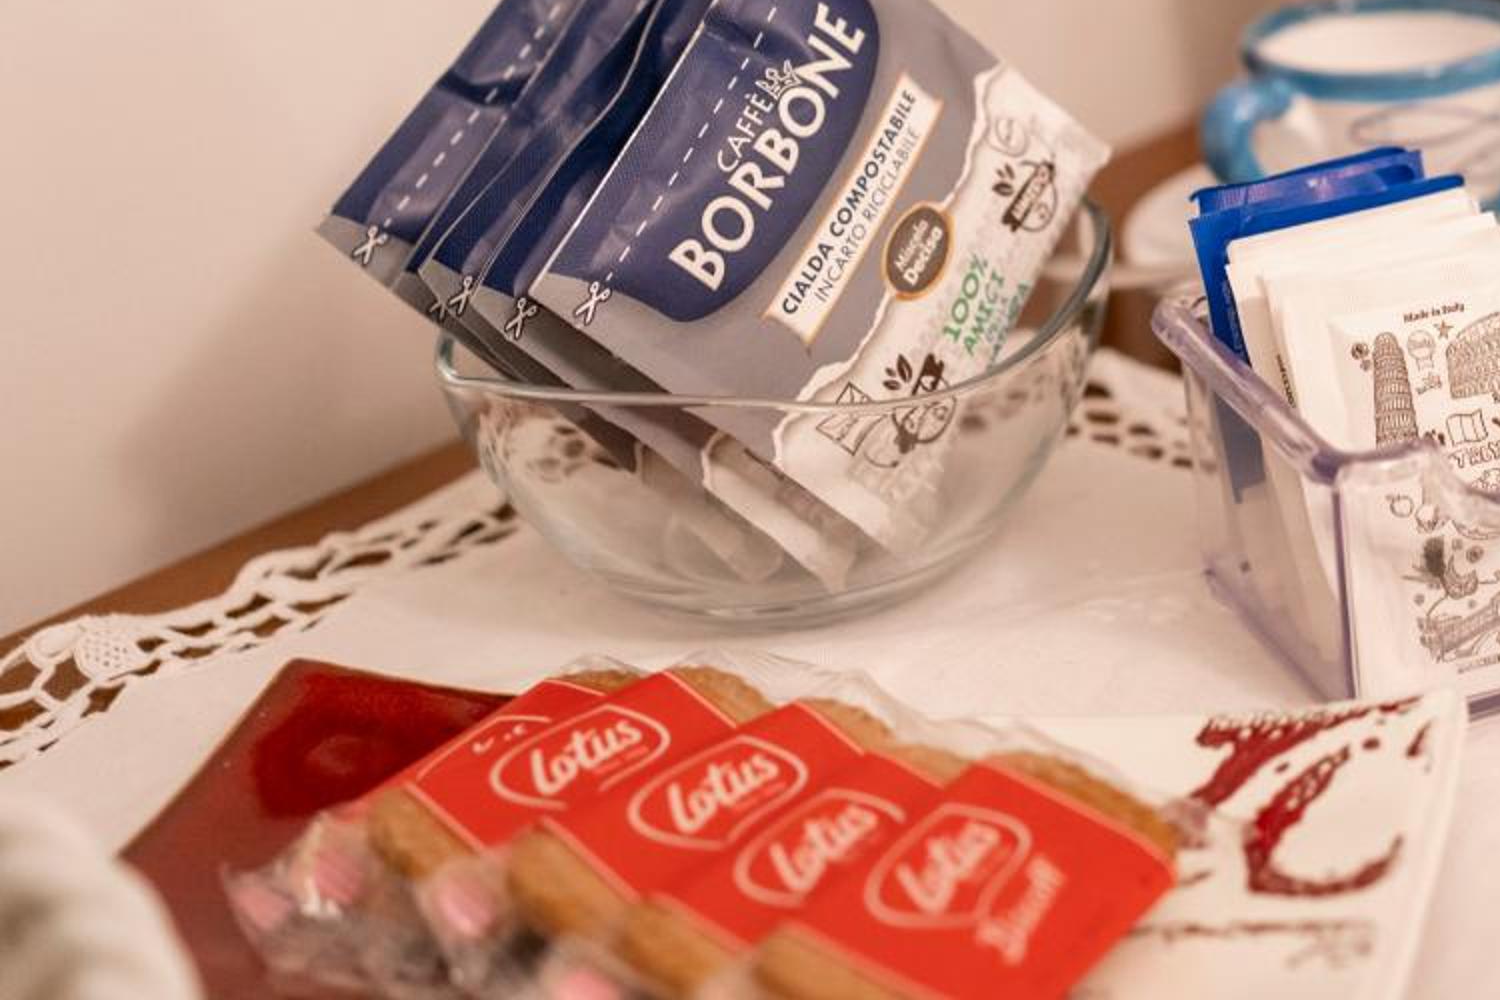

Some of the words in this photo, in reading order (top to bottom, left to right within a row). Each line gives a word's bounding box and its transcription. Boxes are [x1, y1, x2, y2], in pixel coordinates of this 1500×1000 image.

[668, 1, 866, 292] BORBONE
[717, 92, 774, 173] CAFFÈ
[782, 242, 834, 315] CIALDA
[829, 89, 917, 238] COMPOSTABILE
[813, 225, 866, 303] INCARTO
[862, 127, 921, 222] RICICLABILE
[530, 719, 643, 796] Lotus
[667, 752, 779, 834] Lotus
[768, 802, 880, 893] Lotus
[895, 819, 1001, 916] Lotus
